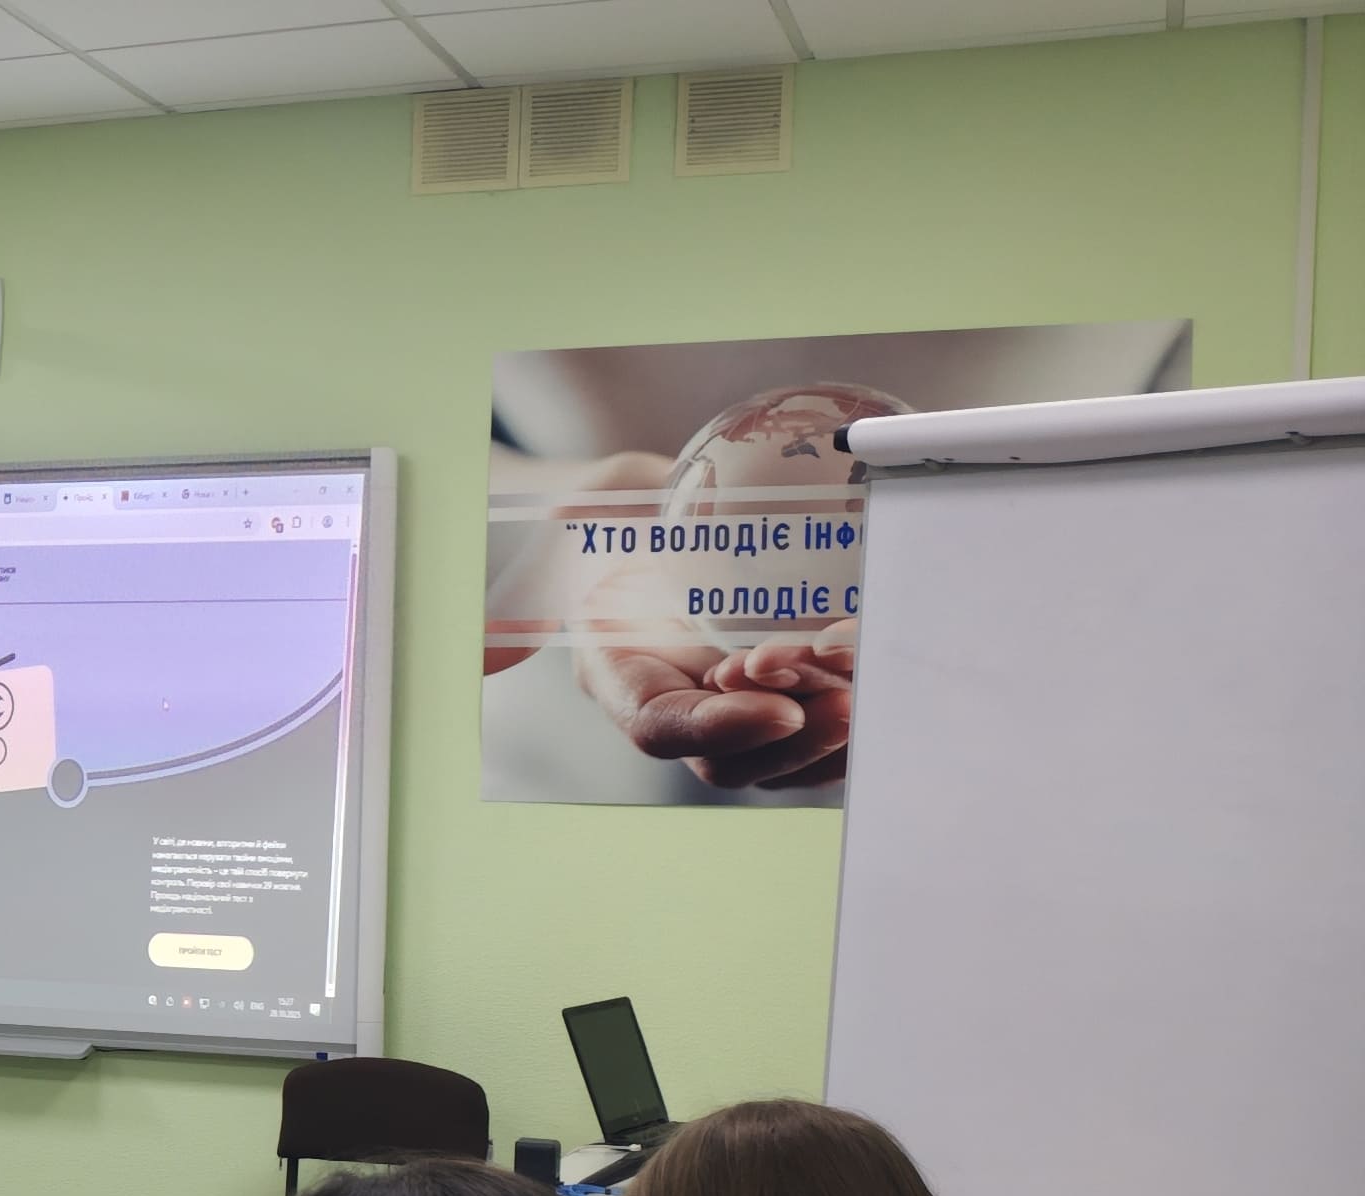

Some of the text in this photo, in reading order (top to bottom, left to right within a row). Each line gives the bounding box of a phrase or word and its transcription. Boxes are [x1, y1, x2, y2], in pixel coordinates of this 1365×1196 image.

[651, 518, 791, 556] володіє
[803, 517, 867, 551] інф
[689, 581, 830, 619] володіє
